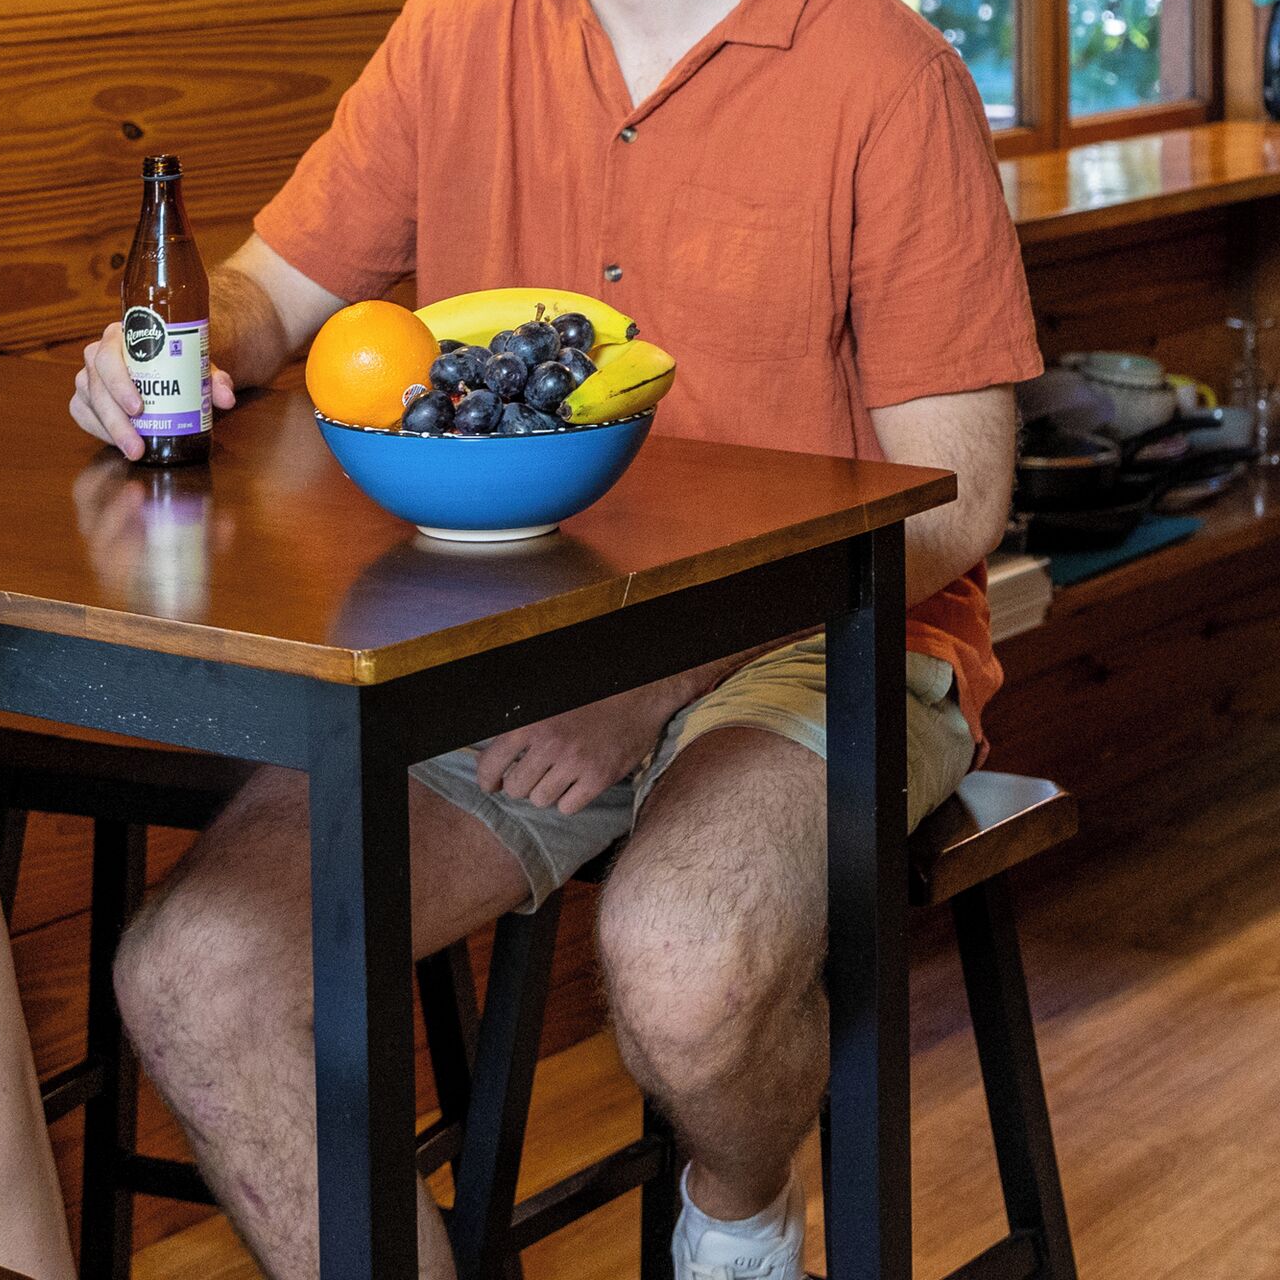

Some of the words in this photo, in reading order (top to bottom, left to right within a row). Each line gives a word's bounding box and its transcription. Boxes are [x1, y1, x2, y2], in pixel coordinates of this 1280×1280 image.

[127, 324, 163, 348] Remedy
[132, 379, 181, 396] BUCHA
[131, 418, 173, 430] SIONFRUIT
[734, 1256, 765, 1269] GUE
